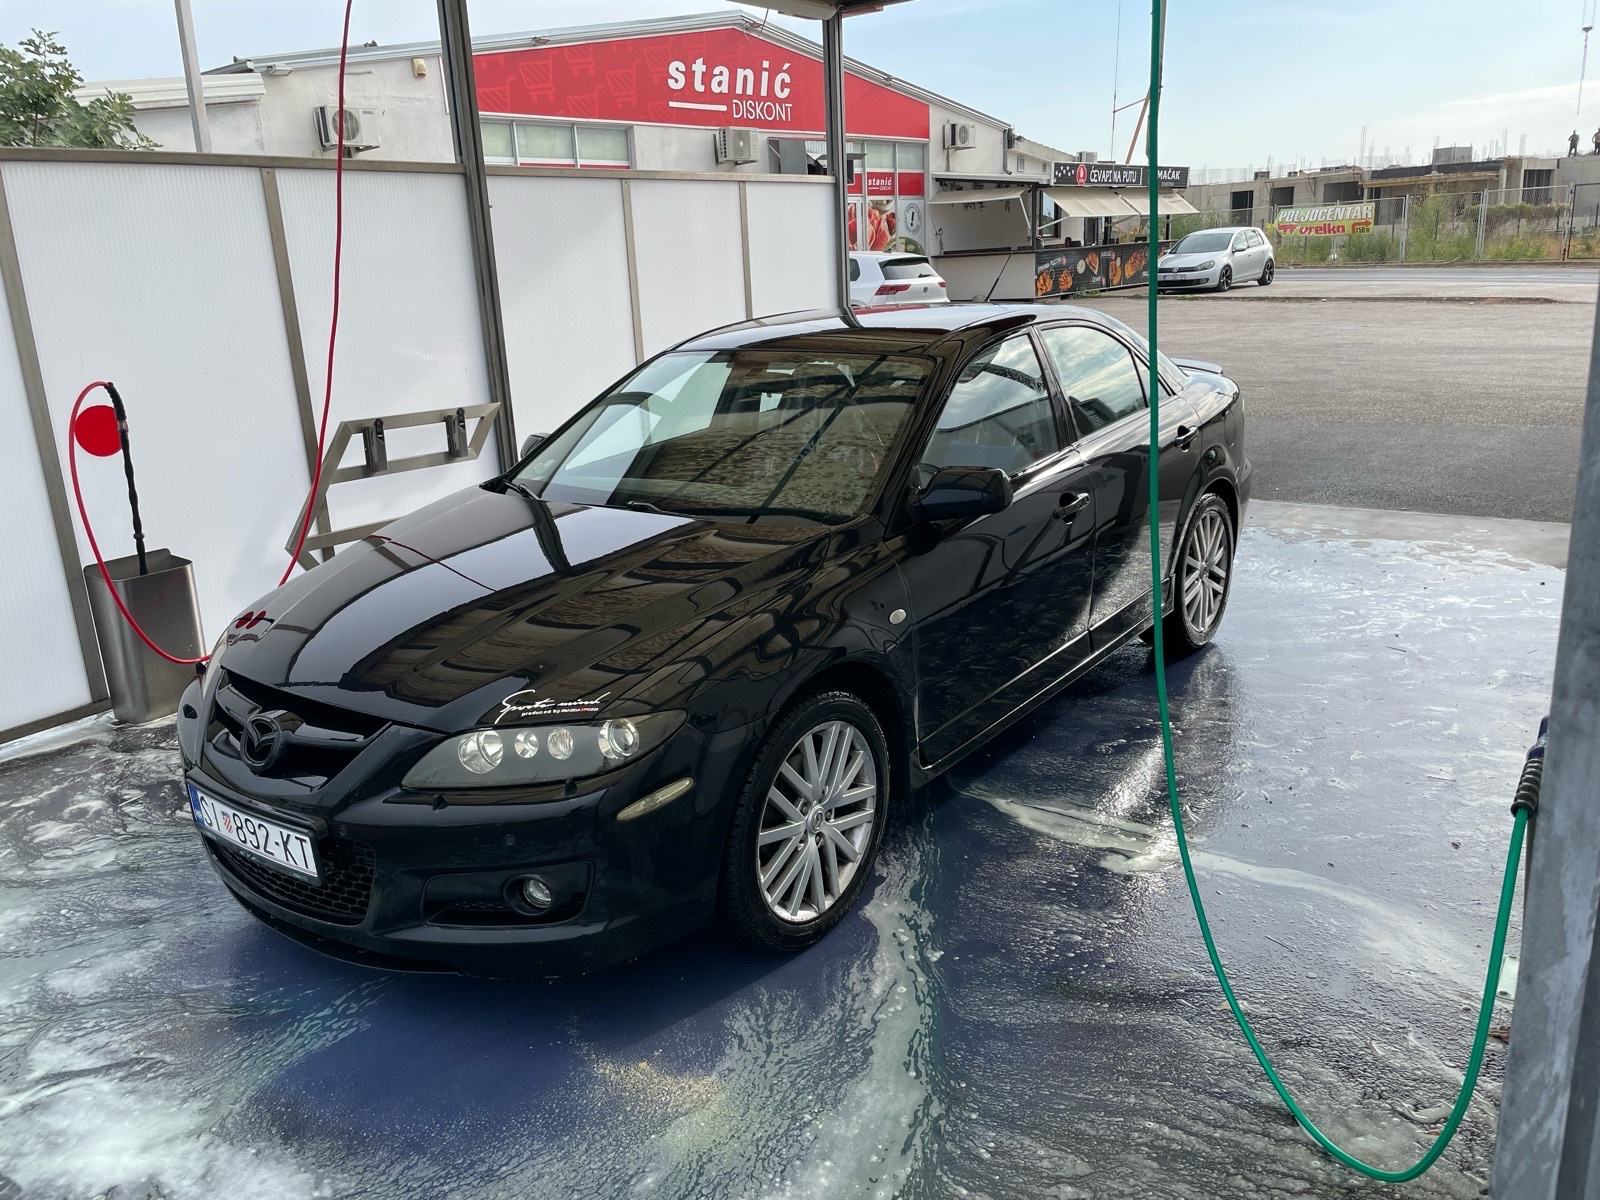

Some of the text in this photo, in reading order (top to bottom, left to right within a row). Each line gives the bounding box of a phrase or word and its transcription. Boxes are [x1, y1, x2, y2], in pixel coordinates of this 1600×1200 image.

[667, 56, 791, 99] stanić
[732, 99, 793, 122] DISKONT
[868, 177, 892, 186] stanić
[1113, 170, 1121, 183] NA
[1122, 170, 1137, 183] PUTU
[1279, 204, 1373, 223] POLJOCENTAR
[1356, 226, 1366, 234] 150
[494, 689, 556, 725] Sports
[521, 708, 552, 717] produced
[200, 796, 309, 870] SI 892-KT
